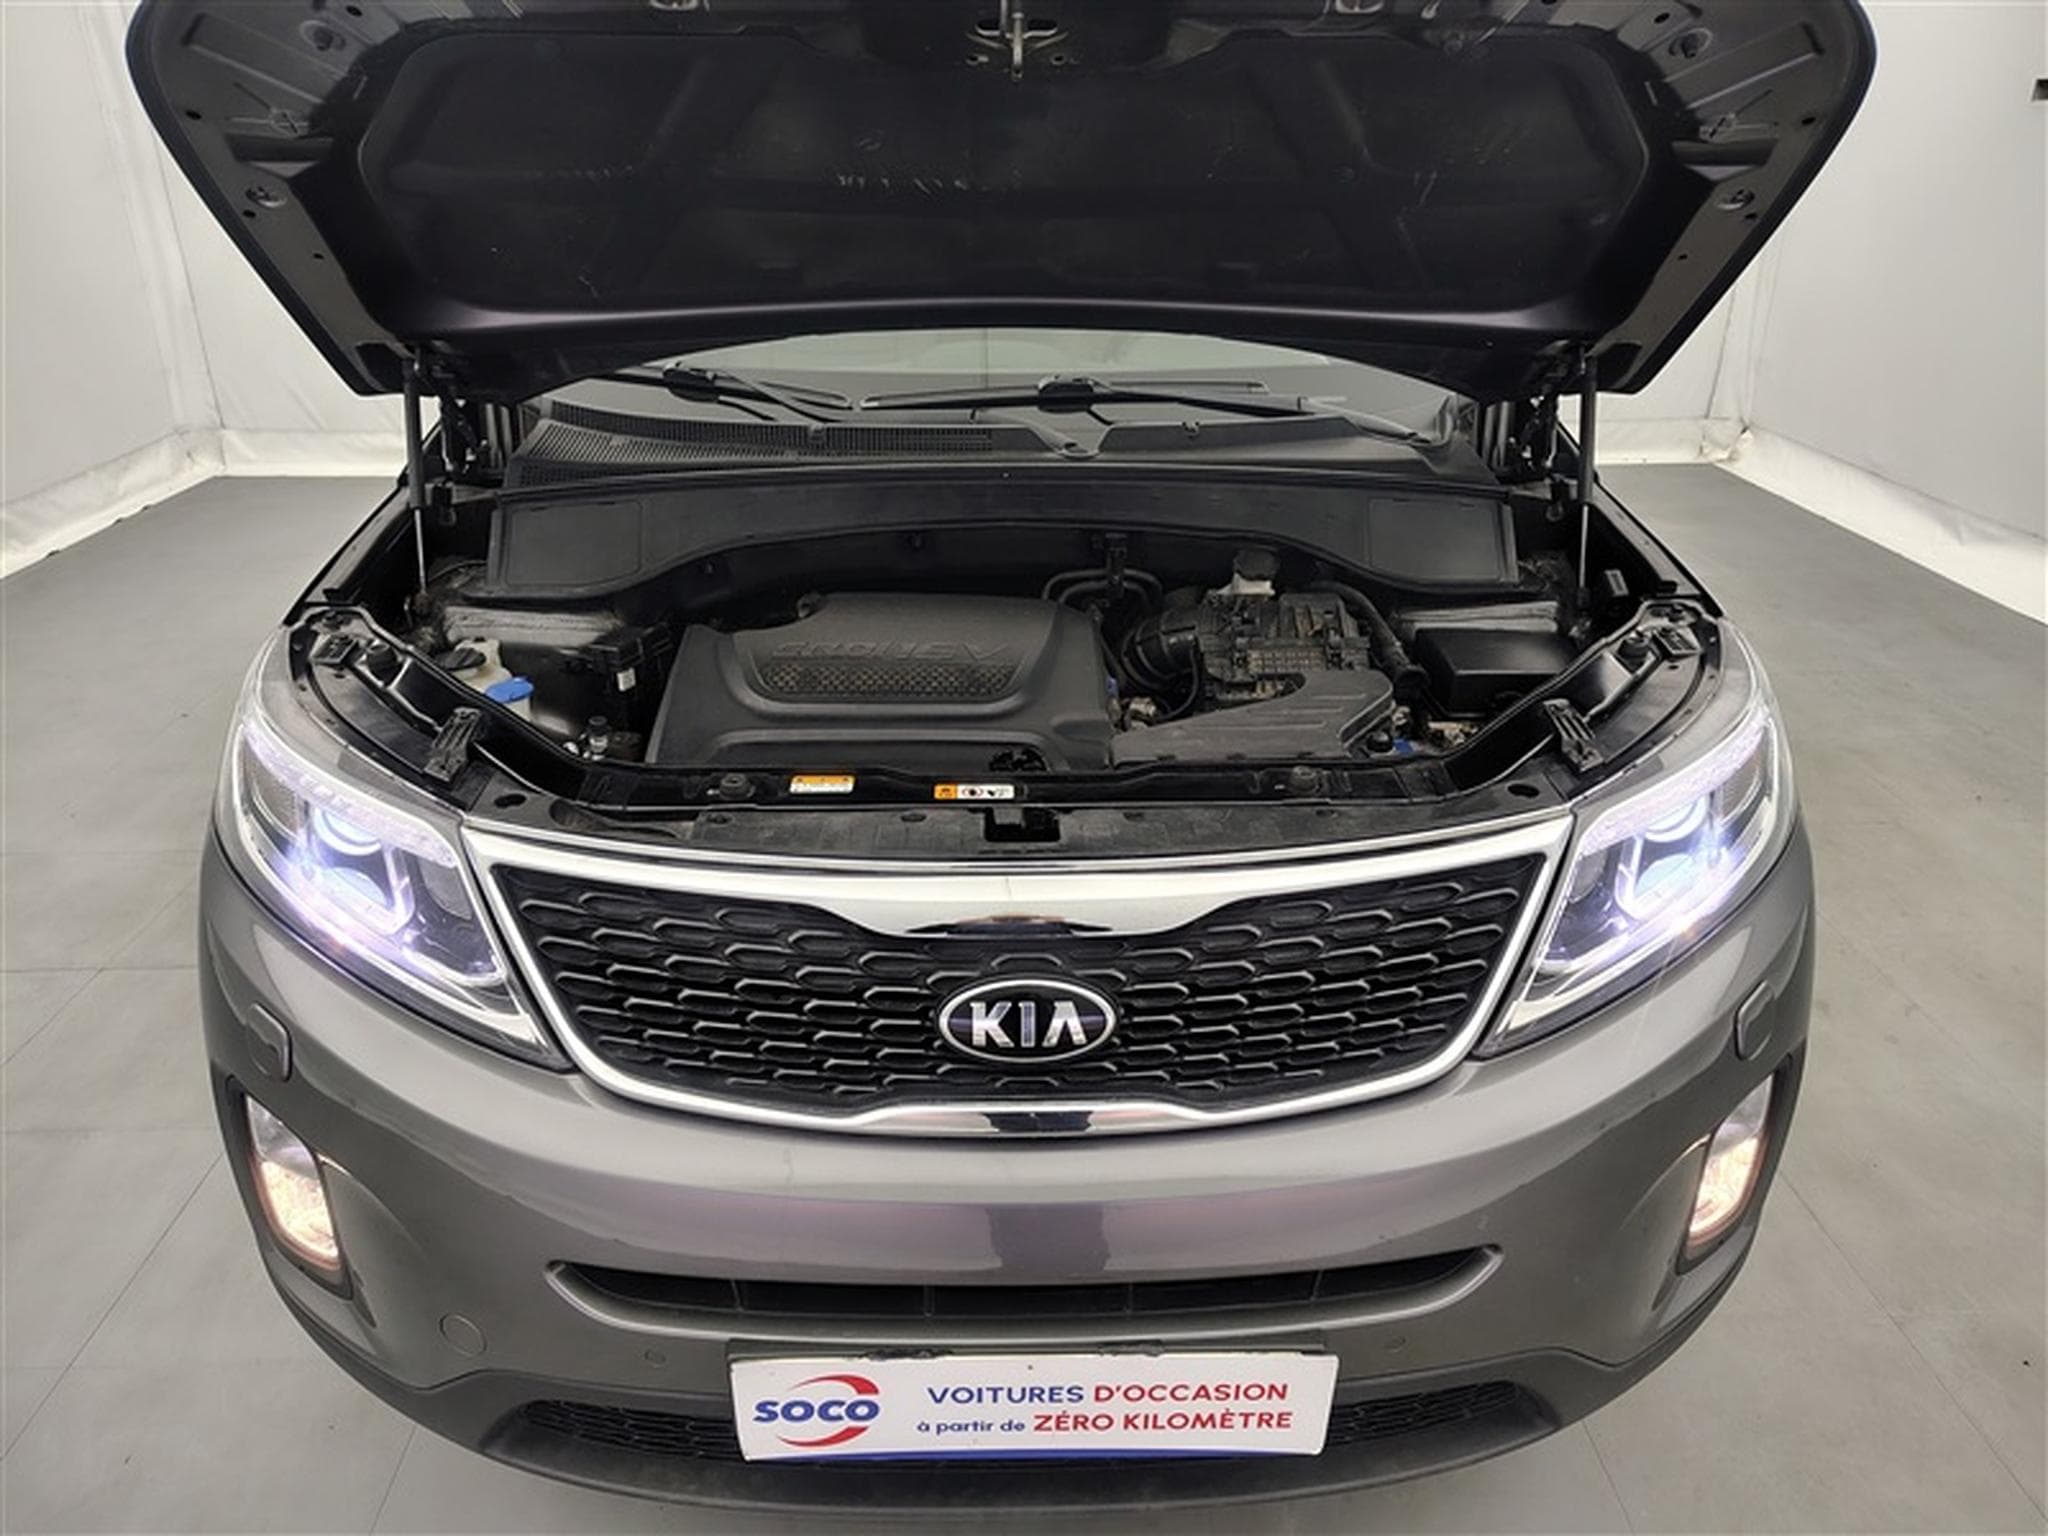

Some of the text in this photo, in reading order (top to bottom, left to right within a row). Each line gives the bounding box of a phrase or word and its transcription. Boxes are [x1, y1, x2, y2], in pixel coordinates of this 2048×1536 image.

[969, 1000, 1088, 1048] KIA
[927, 1383, 1289, 1404] VOITURES D'OCCASION
[753, 1399, 880, 1423] SOCO
[916, 1407, 1293, 1436] à partir de ZÉRO KILOMÈTRE
